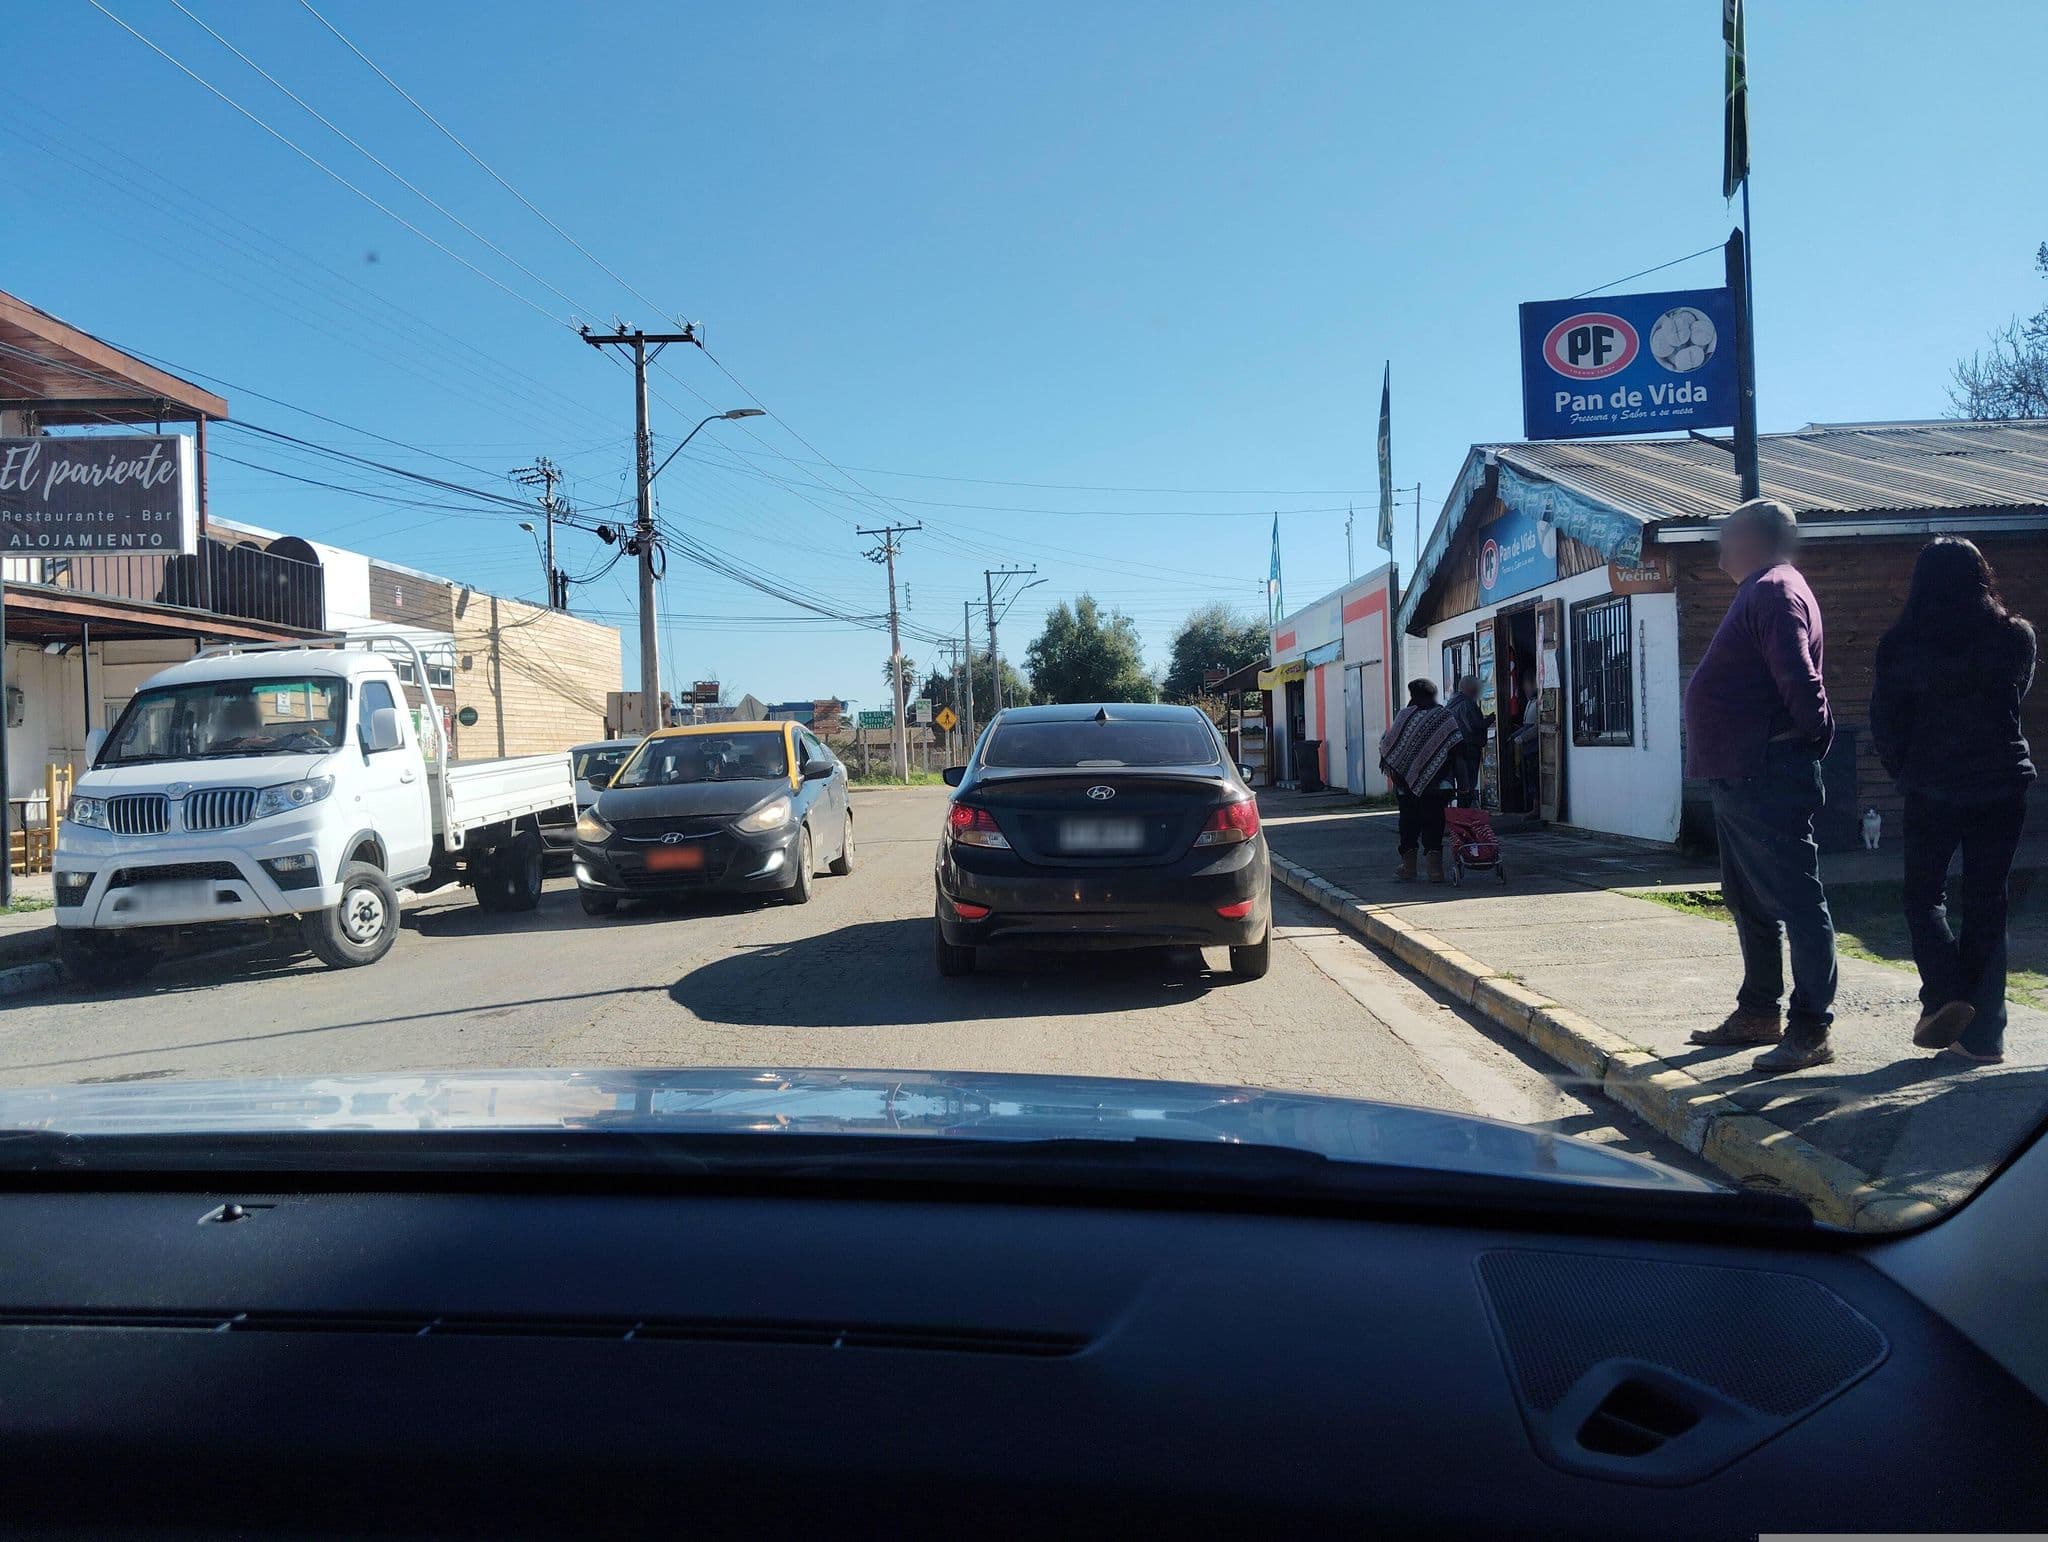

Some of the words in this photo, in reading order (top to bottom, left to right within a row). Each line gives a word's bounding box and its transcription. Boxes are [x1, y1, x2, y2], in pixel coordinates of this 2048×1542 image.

[1568, 325, 1614, 366] PF
[1555, 391, 1603, 413] Pan
[1610, 385, 1643, 408] de
[1648, 380, 1708, 405] Vida
[1569, 413, 1609, 424] Frescura
[1611, 414, 1618, 422] y
[1620, 408, 1647, 420] Sabor
[1672, 407, 1694, 416] mesa
[0, 440, 41, 491] El
[43, 443, 177, 501] pariente
[2, 510, 115, 522] Restaurante
[142, 509, 172, 521] Bar
[10, 533, 163, 547] ALOJAMIENTO
[1500, 545, 1511, 563] Pan
[1521, 530, 1536, 553] Vida
[1616, 569, 1660, 582] Vecina
